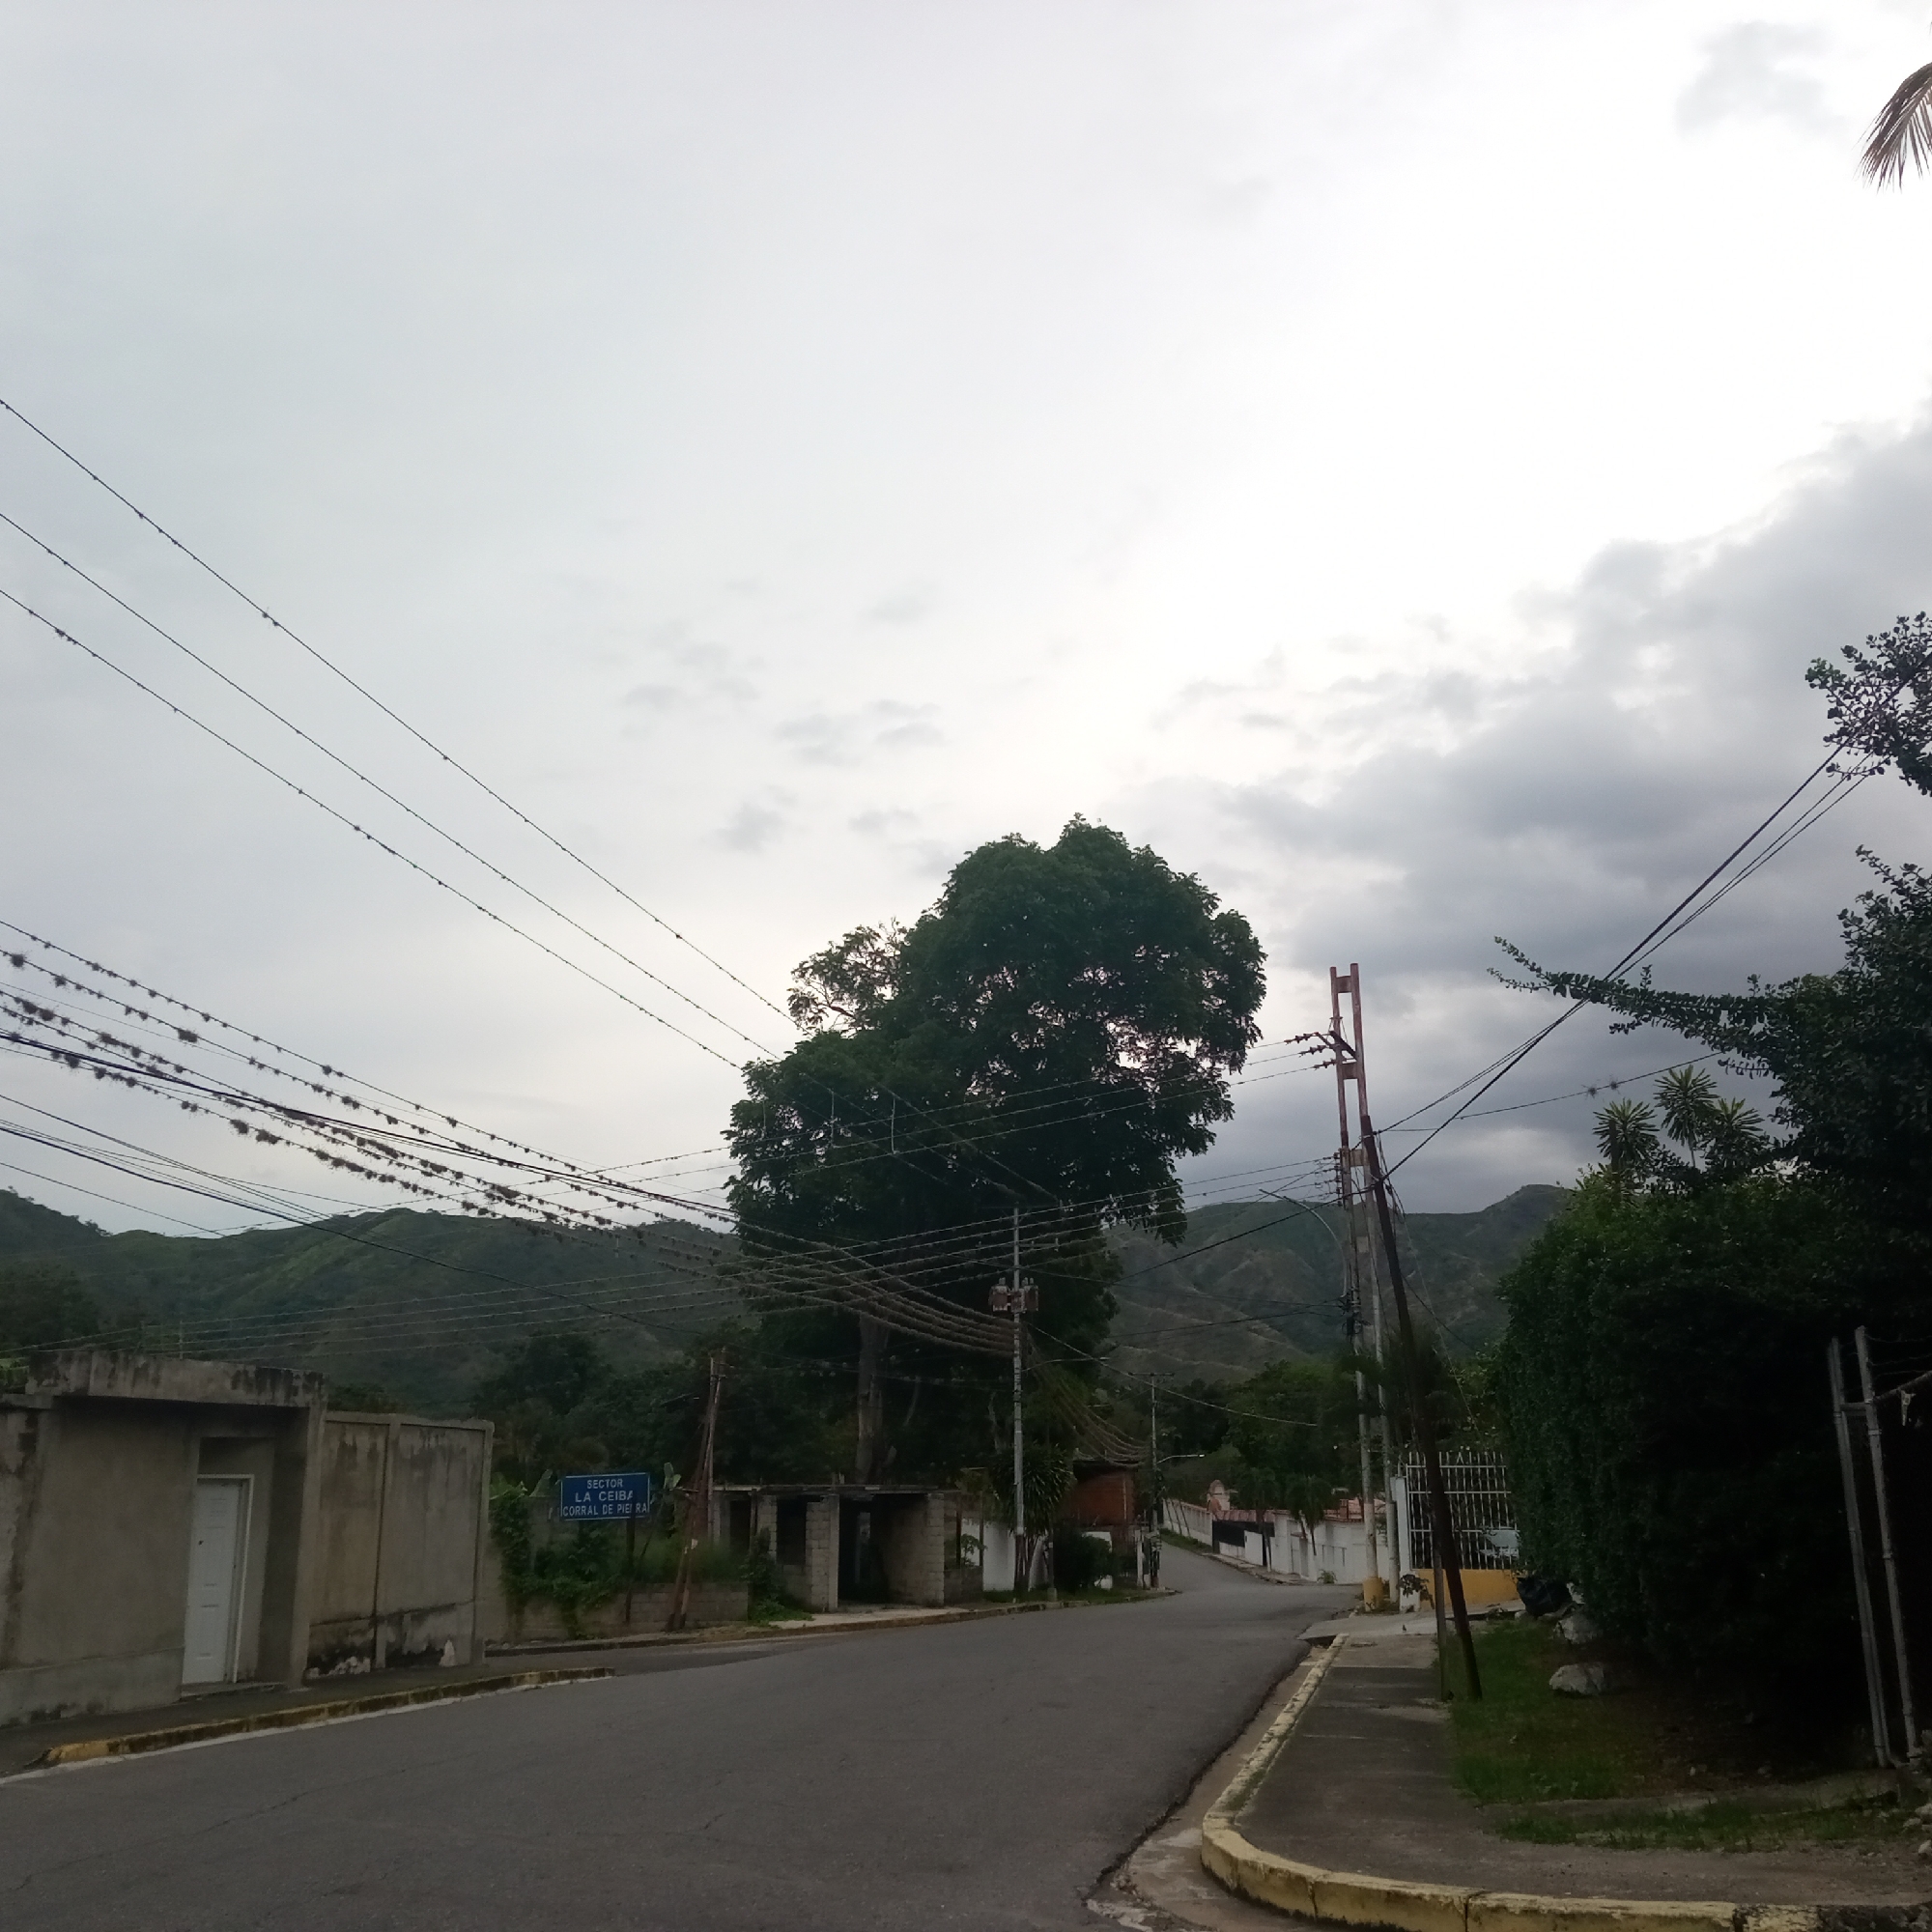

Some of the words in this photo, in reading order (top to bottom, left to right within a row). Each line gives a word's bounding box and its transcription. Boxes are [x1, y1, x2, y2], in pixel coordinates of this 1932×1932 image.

[586, 1479, 623, 1489] SECTOR
[575, 1492, 591, 1502] LA
[562, 1505, 599, 1517] CORRAL
[602, 1504, 613, 1515] DE
